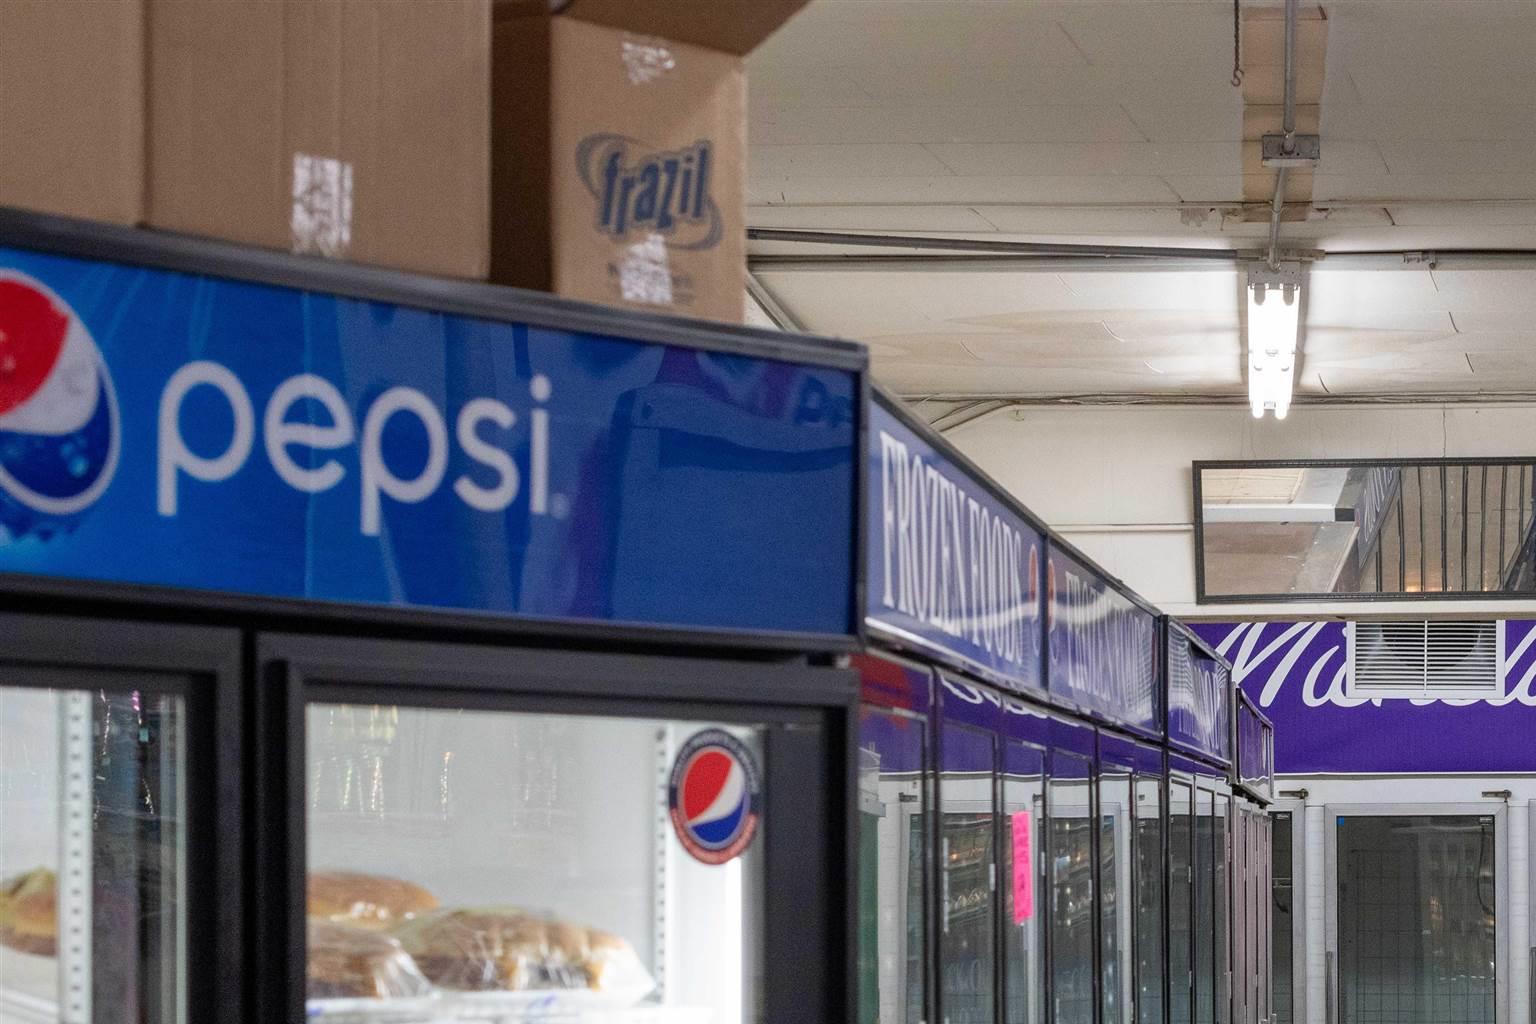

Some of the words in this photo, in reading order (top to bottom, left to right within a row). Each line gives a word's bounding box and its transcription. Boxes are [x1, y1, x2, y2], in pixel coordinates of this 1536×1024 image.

[601, 138, 714, 235] frazil
[156, 361, 551, 537] pepsi
[880, 430, 967, 638] FROZEN
[967, 497, 1023, 665] FOODS
